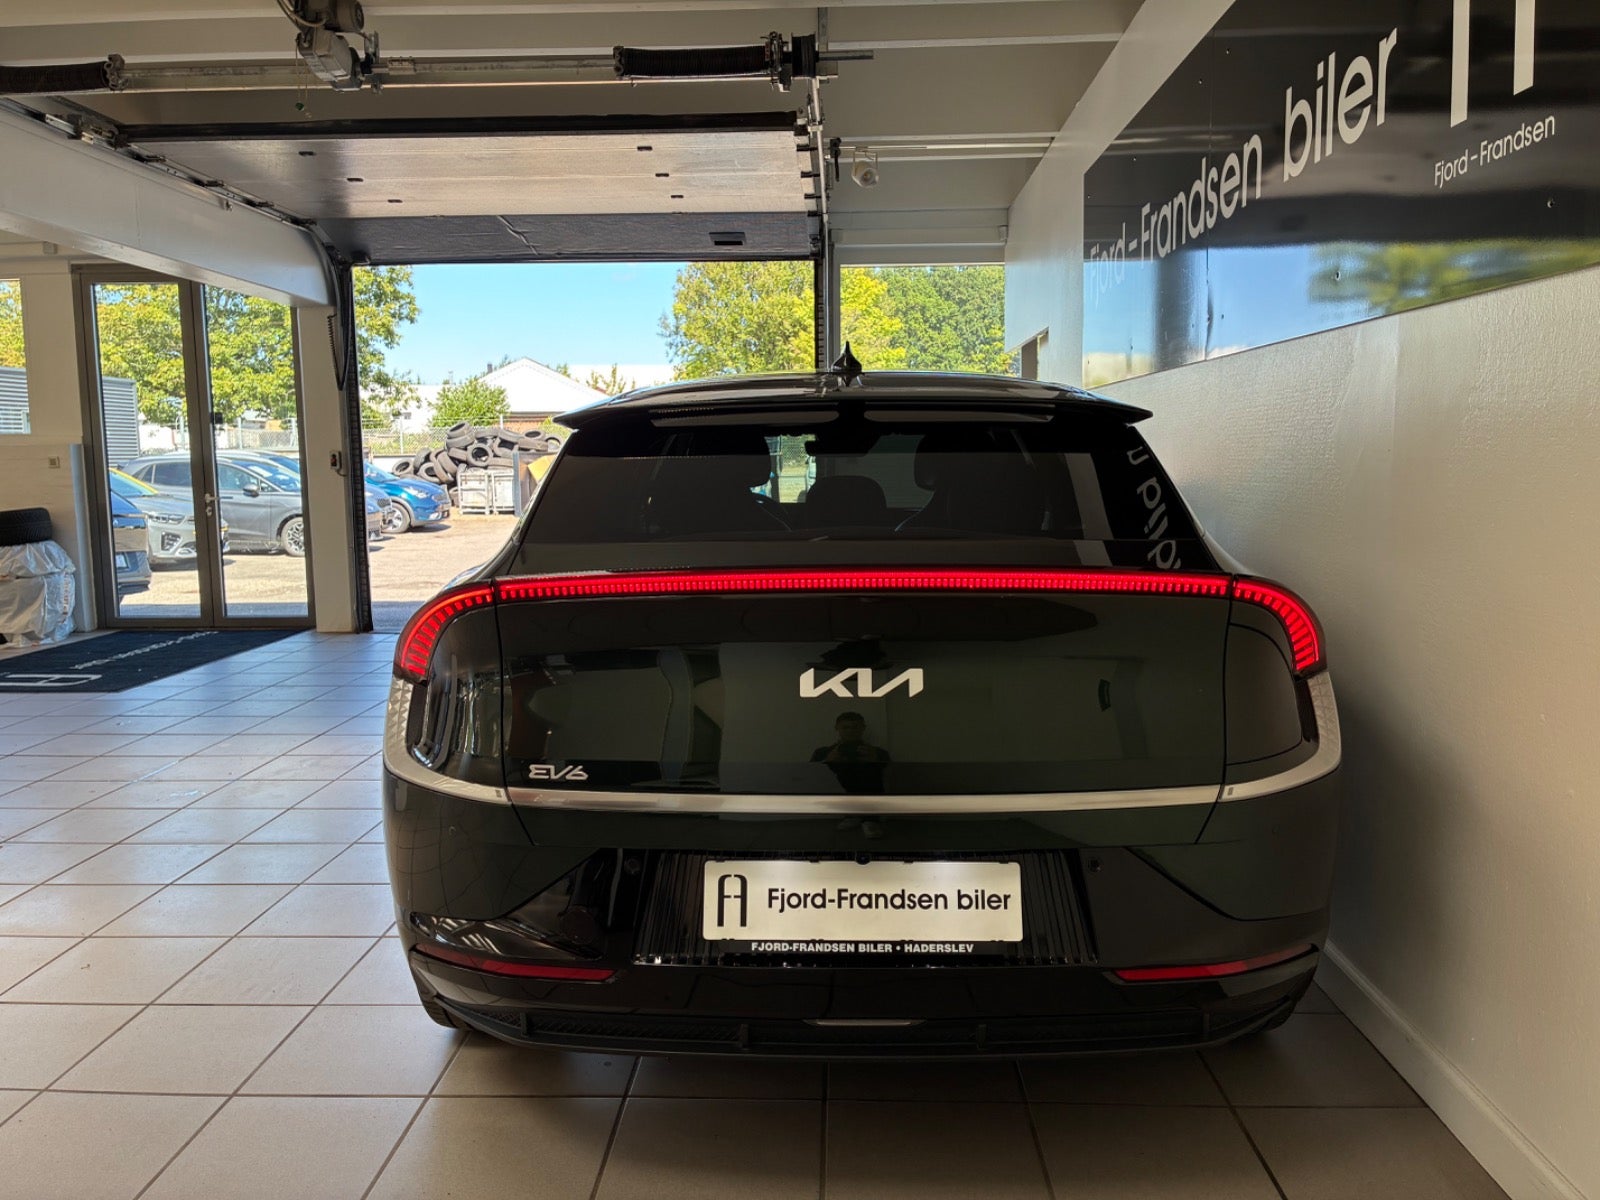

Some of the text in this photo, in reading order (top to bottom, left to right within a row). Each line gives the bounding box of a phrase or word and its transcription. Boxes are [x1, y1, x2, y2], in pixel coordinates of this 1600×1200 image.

[1089, 27, 1398, 310] Fjord-Frandsen biler
[799, 667, 924, 698] KIA
[528, 763, 589, 781] EV6
[767, 887, 1011, 914] Fjord-Frandsen biler
[751, 942, 974, 953] FJORD-FRANDSEN BILER HADERSLEV
